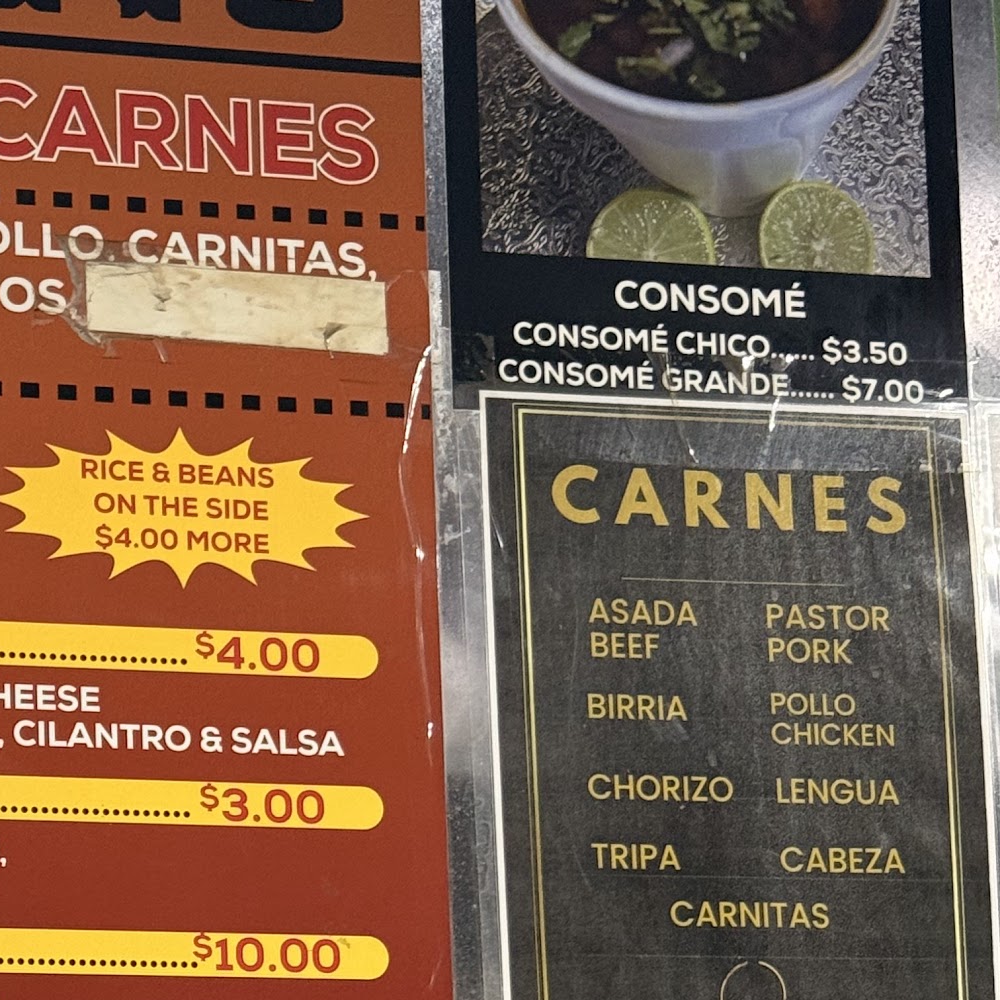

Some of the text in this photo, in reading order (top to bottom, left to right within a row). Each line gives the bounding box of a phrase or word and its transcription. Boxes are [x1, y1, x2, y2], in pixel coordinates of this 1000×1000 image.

[127, 229, 381, 283] CARNITAS,
[615, 280, 806, 318] CONSOMÉ
[514, 322, 668, 353] CONSOMÉ
[823, 338, 907, 365] $3.50
[499, 359, 654, 389] CONSOMÉ
[843, 377, 926, 405] $7.00
[81, 459, 274, 488] RICE & BEANS
[94, 493, 268, 520] ON THE SIDE
[552, 462, 906, 534] CARNES
[96, 524, 269, 553] $4.00 MORE
[589, 598, 697, 626] ASADA
[767, 604, 890, 631] PASTOR
[192, 628, 323, 672] $4.00
[591, 632, 659, 658] BEEF
[768, 638, 852, 664] PORK
[588, 694, 687, 720] BIRRIA
[771, 693, 855, 716] POLLO
[14, 720, 191, 751] CILANTRO
[201, 727, 222, 752] &
[232, 727, 344, 756] SALSA
[772, 723, 894, 746] CHICKEN
[588, 774, 733, 802] CHORIZO
[776, 778, 899, 805] LENGUA
[197, 781, 328, 824] $3.00
[591, 844, 680, 870] TRIPA
[780, 847, 905, 873] CABEZA
[671, 901, 829, 928] CARNITAS
[189, 931, 343, 973] $10.00
